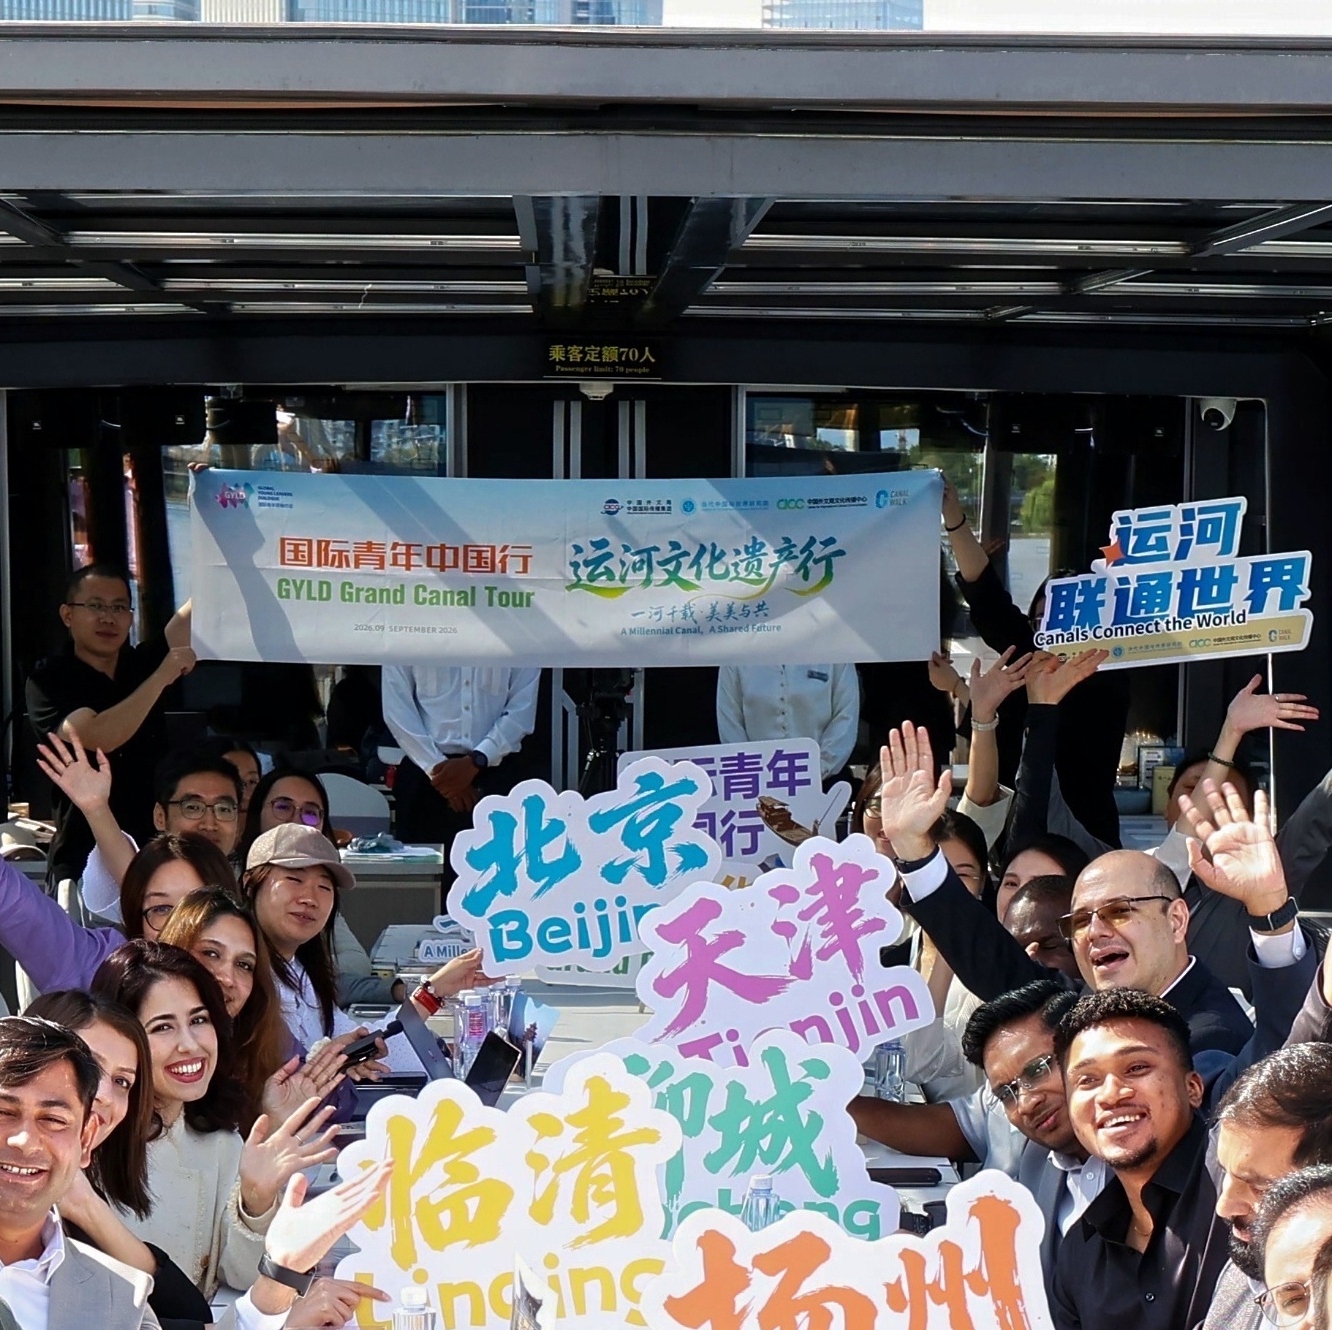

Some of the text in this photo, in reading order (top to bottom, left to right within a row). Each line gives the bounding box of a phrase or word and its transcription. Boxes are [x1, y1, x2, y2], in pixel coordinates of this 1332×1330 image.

[549, 344, 656, 363] 乘客定额70人
[279, 537, 534, 574] 国际青年中国行
[1112, 502, 1243, 566] 运河
[277, 578, 535, 608] GYLD Grand Canal Tour
[566, 536, 846, 600] 运河文化遗产行
[1046, 556, 1308, 632] 联通世界
[388, 625, 437, 634] SEPTEMBER
[629, 627, 674, 635] Millennial
[718, 624, 749, 633] Shared
[752, 623, 781, 632] Future
[1035, 609, 1246, 646] Canals Connect the World
[462, 772, 709, 917] 北京
[424, 944, 433, 958] A
[651, 852, 888, 1044] 天津
[677, 985, 920, 1067] Tinjin
[358, 1079, 663, 1271] 临清
